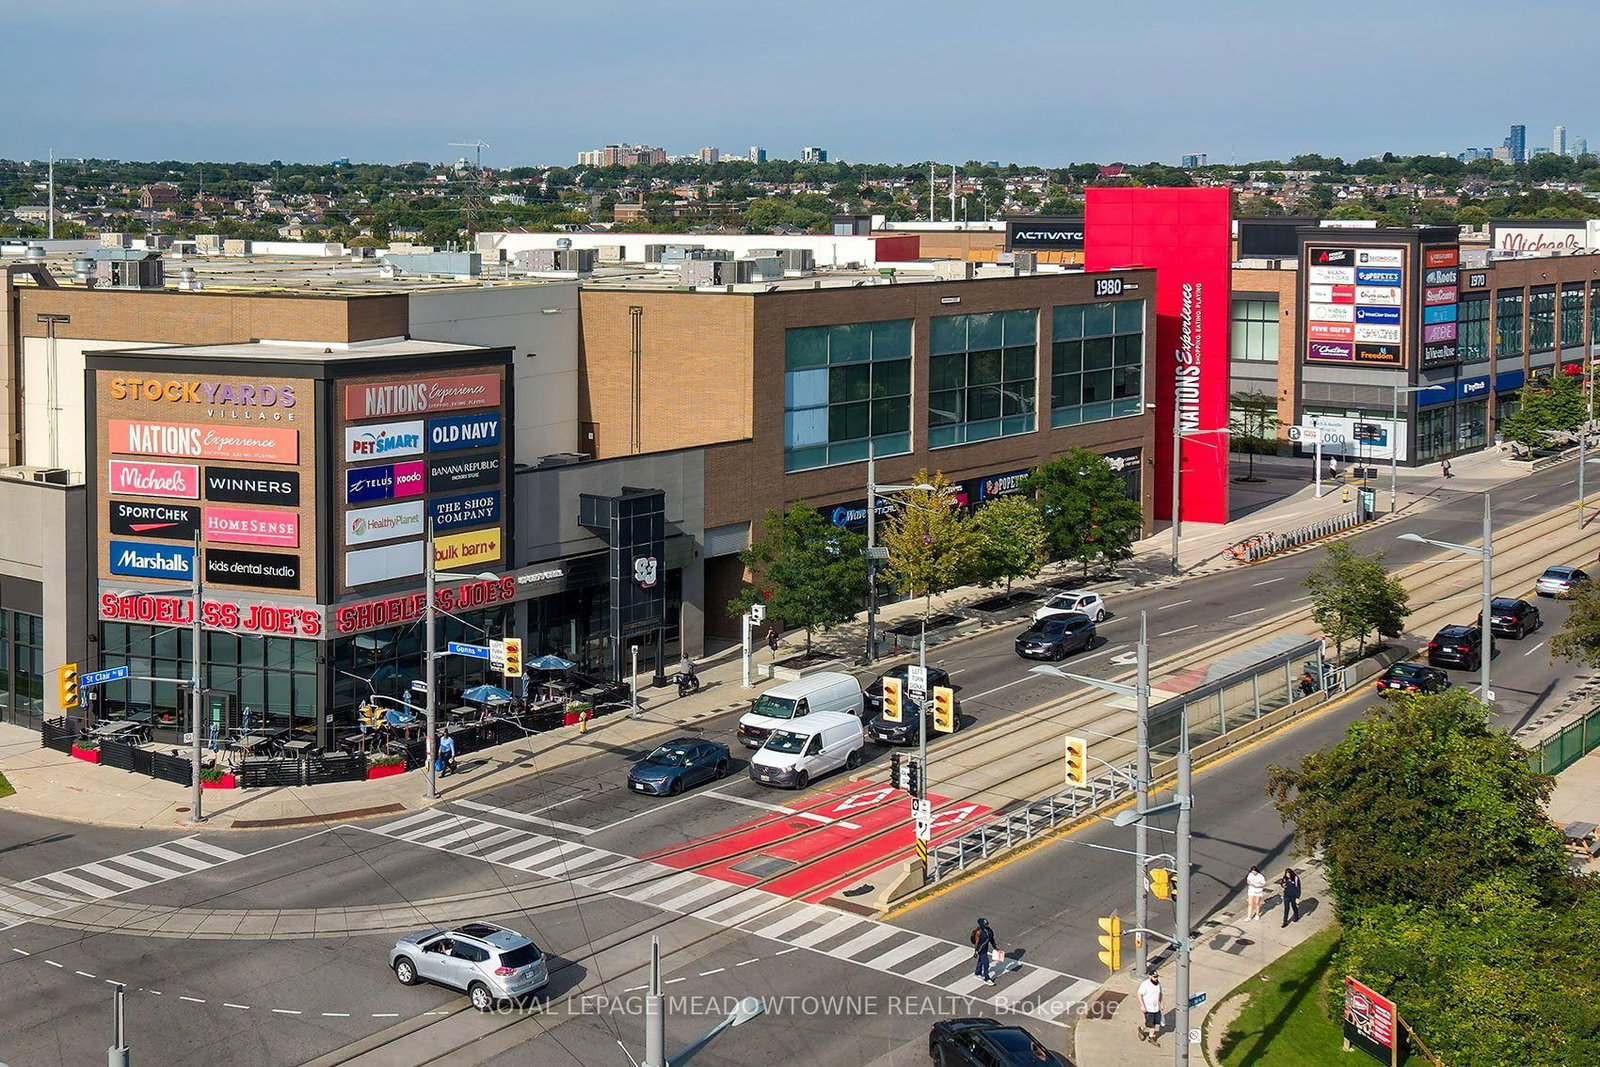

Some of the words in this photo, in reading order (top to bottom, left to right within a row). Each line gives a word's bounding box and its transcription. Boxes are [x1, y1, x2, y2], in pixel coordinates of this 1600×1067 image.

[1015, 231, 1084, 240] ACTIVATE
[1436, 271, 1456, 283] Roots
[1470, 275, 1484, 286] 1970
[1096, 279, 1122, 296] 1980
[1176, 283, 1196, 365] Experience
[1361, 352, 1394, 360] Freedom
[110, 377, 296, 408] STOCKYARDS
[365, 383, 428, 416] NATIONS
[428, 382, 486, 403] Experience
[1175, 363, 1200, 432] NATIONS
[207, 409, 295, 421] VILLAGE
[129, 424, 201, 456] NATIONS
[204, 430, 276, 450] Experience
[432, 426, 459, 444] OLD
[462, 421, 498, 440] NAVY
[432, 464, 463, 476] BANANA
[464, 460, 498, 473] REPUBLIC
[120, 467, 186, 492] Michaels
[210, 478, 292, 494] WINNERS
[366, 478, 392, 488] TELUS
[437, 502, 460, 514] THE
[464, 496, 494, 510] SHOE
[437, 508, 494, 524] COMPANY
[462, 542, 488, 558] barn
[118, 550, 188, 572] Marshalls
[209, 560, 228, 572] kids
[230, 562, 262, 575] dental
[263, 565, 295, 578] studio
[458, 576, 515, 610] JOE'S
[244, 606, 321, 636] JOE'S
[456, 645, 476, 654] Gunns
[86, 675, 93, 684] St
[95, 672, 110, 682] Clair
